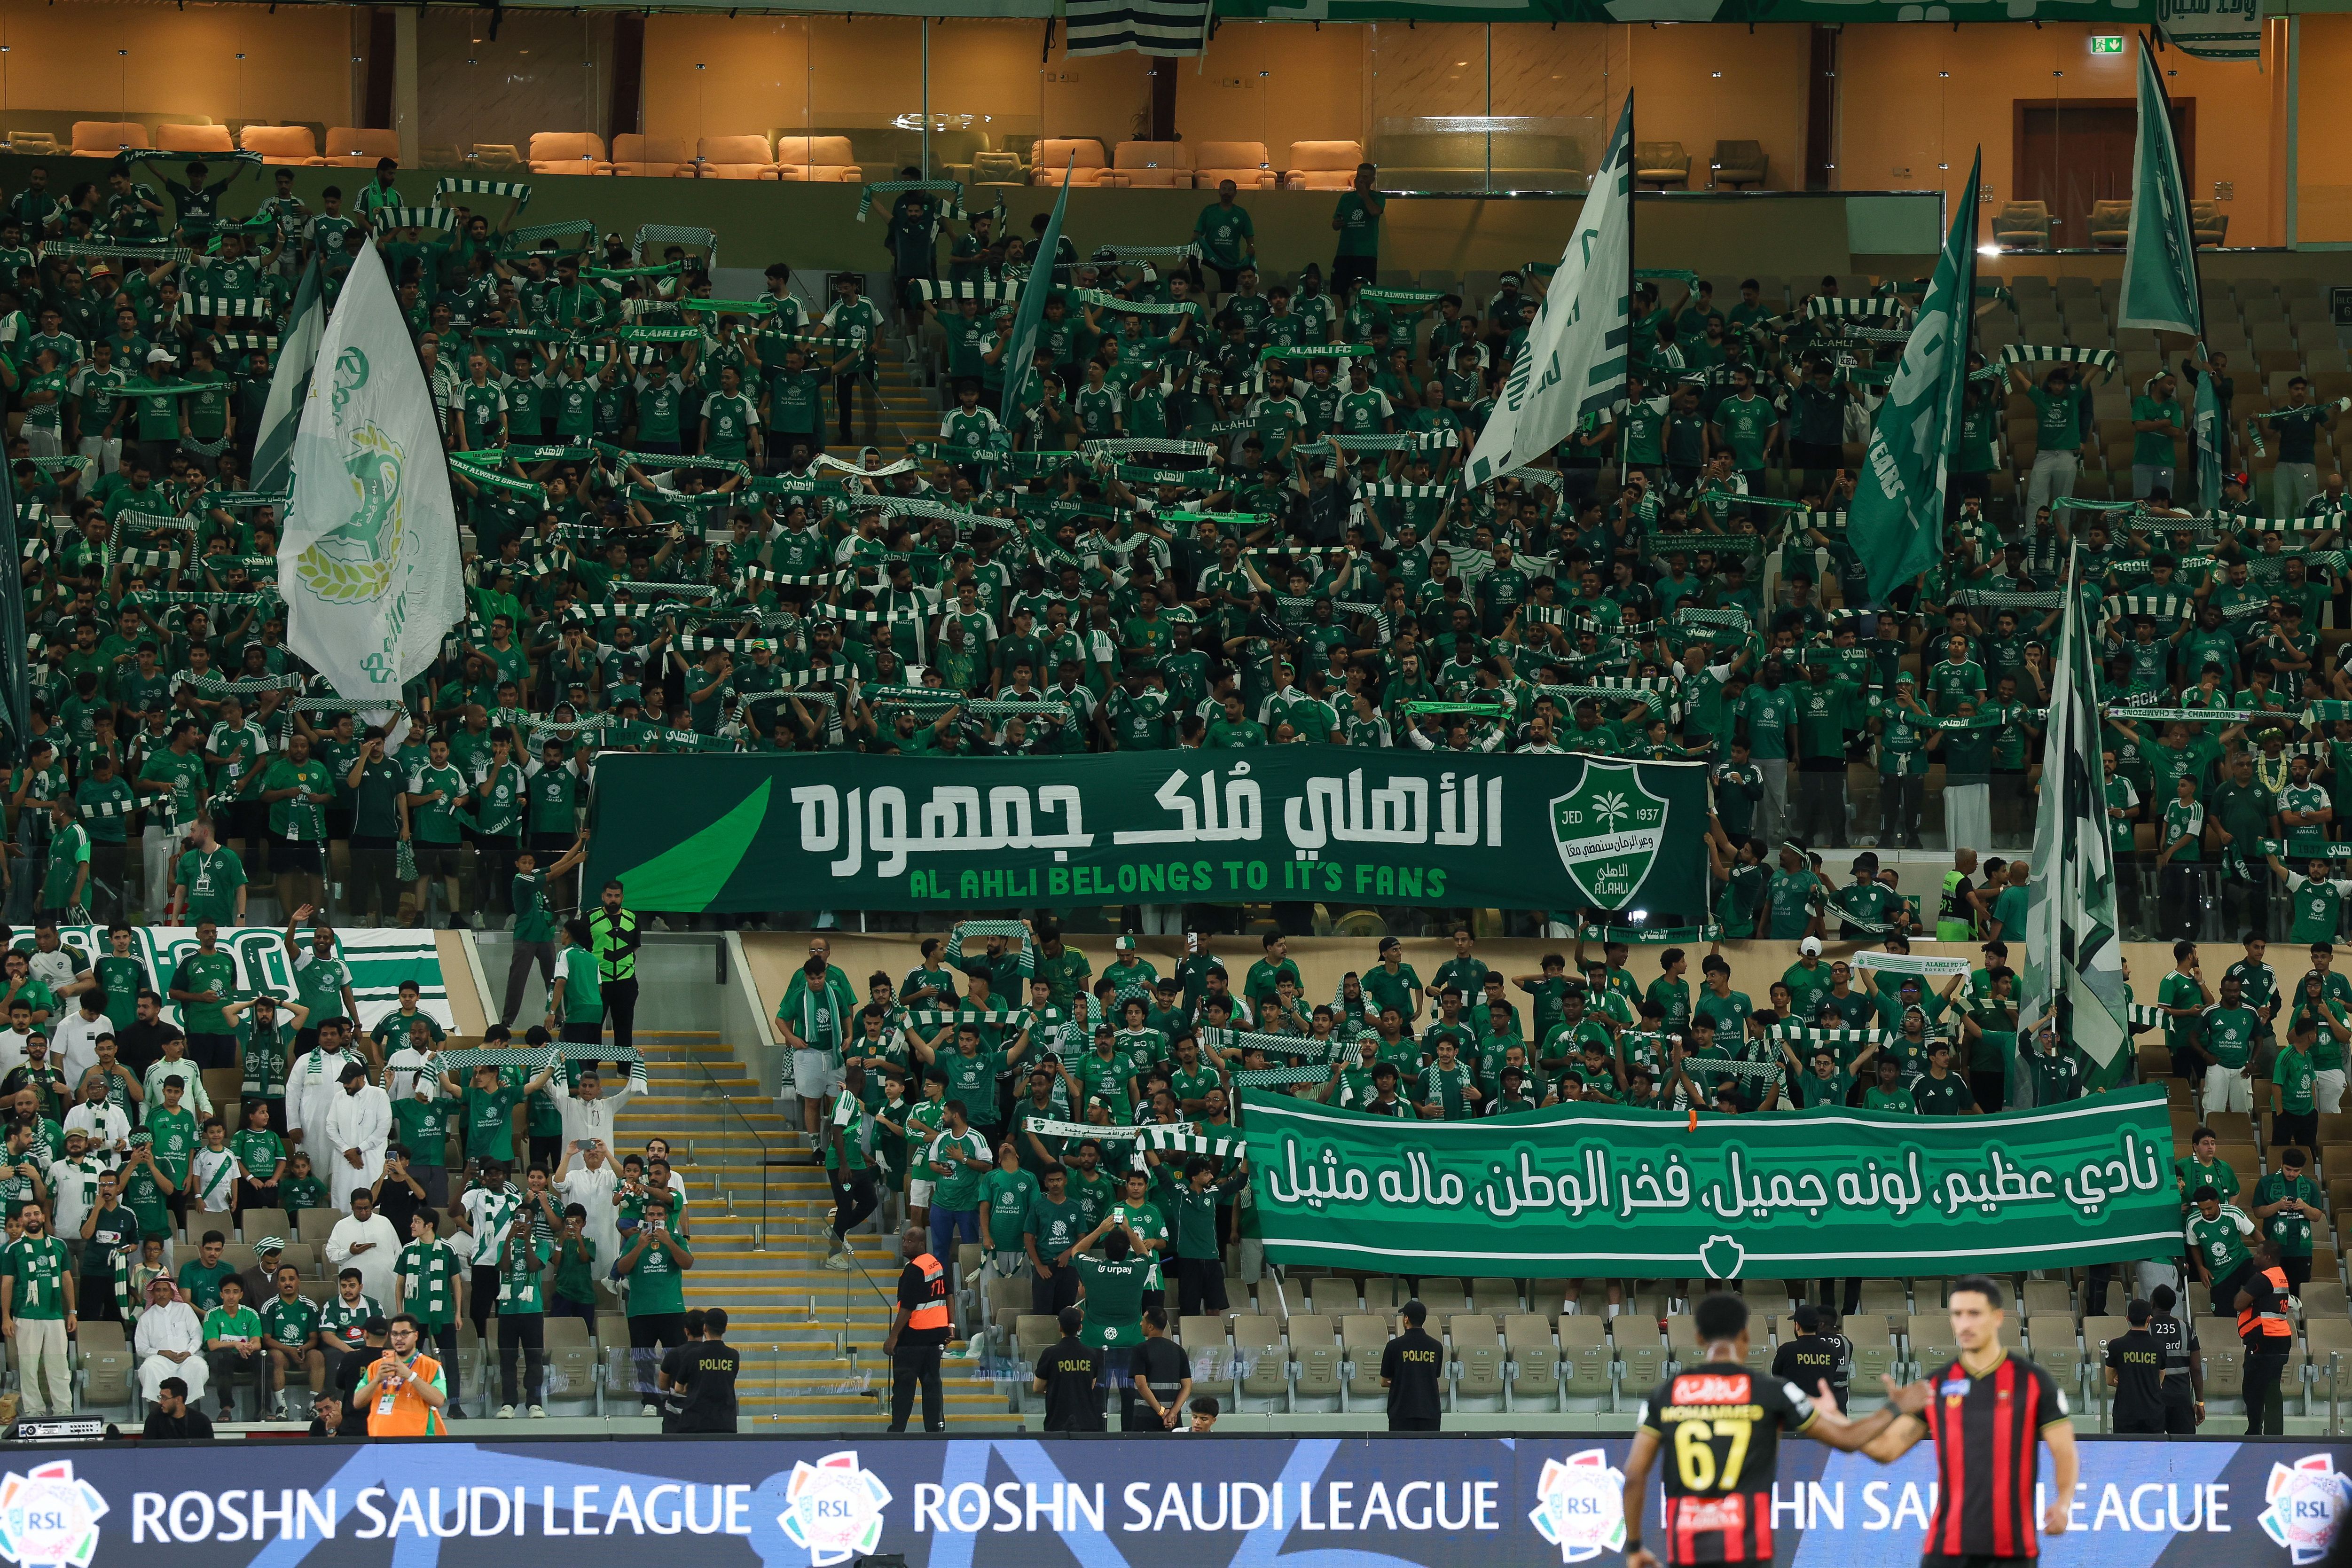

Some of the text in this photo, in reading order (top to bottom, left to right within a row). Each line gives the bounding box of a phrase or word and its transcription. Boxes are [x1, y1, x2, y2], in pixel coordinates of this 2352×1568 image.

[1384, 291, 1414, 299] ALWAYS
[629, 330, 678, 339] ALAHLI
[1287, 346, 1332, 355] ALAHLI
[1211, 419, 1255, 432] AL-AHLI
[535, 446, 564, 457] الأهلي
[1870, 427, 1905, 500] YEARS
[469, 466, 501, 483] ALWAYS
[1154, 471, 1184, 482] الأهلي
[783, 480, 814, 492] الأهلي
[1051, 500, 1080, 510] الأهلي
[242, 557, 273, 567] الأهلي
[1051, 548, 1078, 566] الأهلي
[1686, 628, 1716, 637] الأهلي
[615, 730, 636, 742] 1937
[666, 729, 725, 747] الأهلي 1937
[791, 761, 1502, 877] الأهلي مُلك جمهوره
[1562, 808, 1659, 825] JED 1937
[1566, 836, 1653, 857] وعبر الزمان سنمضي معًا
[910, 861, 1445, 898] AL AHLI BELONGS TO IT'S FANS
[1639, 929, 1667, 940] الأهلي
[1269, 1135, 2160, 1218] نادي عظيم، لونه جميل، فخر الوطن، ماله مثيل
[2156, 1324, 2176, 1334] 235
[1402, 1350, 1435, 1363] POLICE
[1797, 1354, 1831, 1365] POLICE
[2123, 1351, 2156, 1364] POLICE
[699, 1359, 733, 1372] POLICE
[1058, 1360, 1091, 1372] POLICE
[1675, 1420, 1751, 1491] 67
[817, 1481, 1500, 1532] RSL ROSHN SAUDI LEAGUE
[1568, 1497, 1602, 1515] RSL
[2294, 1501, 2331, 1518] RSL
[29, 1484, 752, 1544] RSL ROSHN SAUDI LEAGUE
